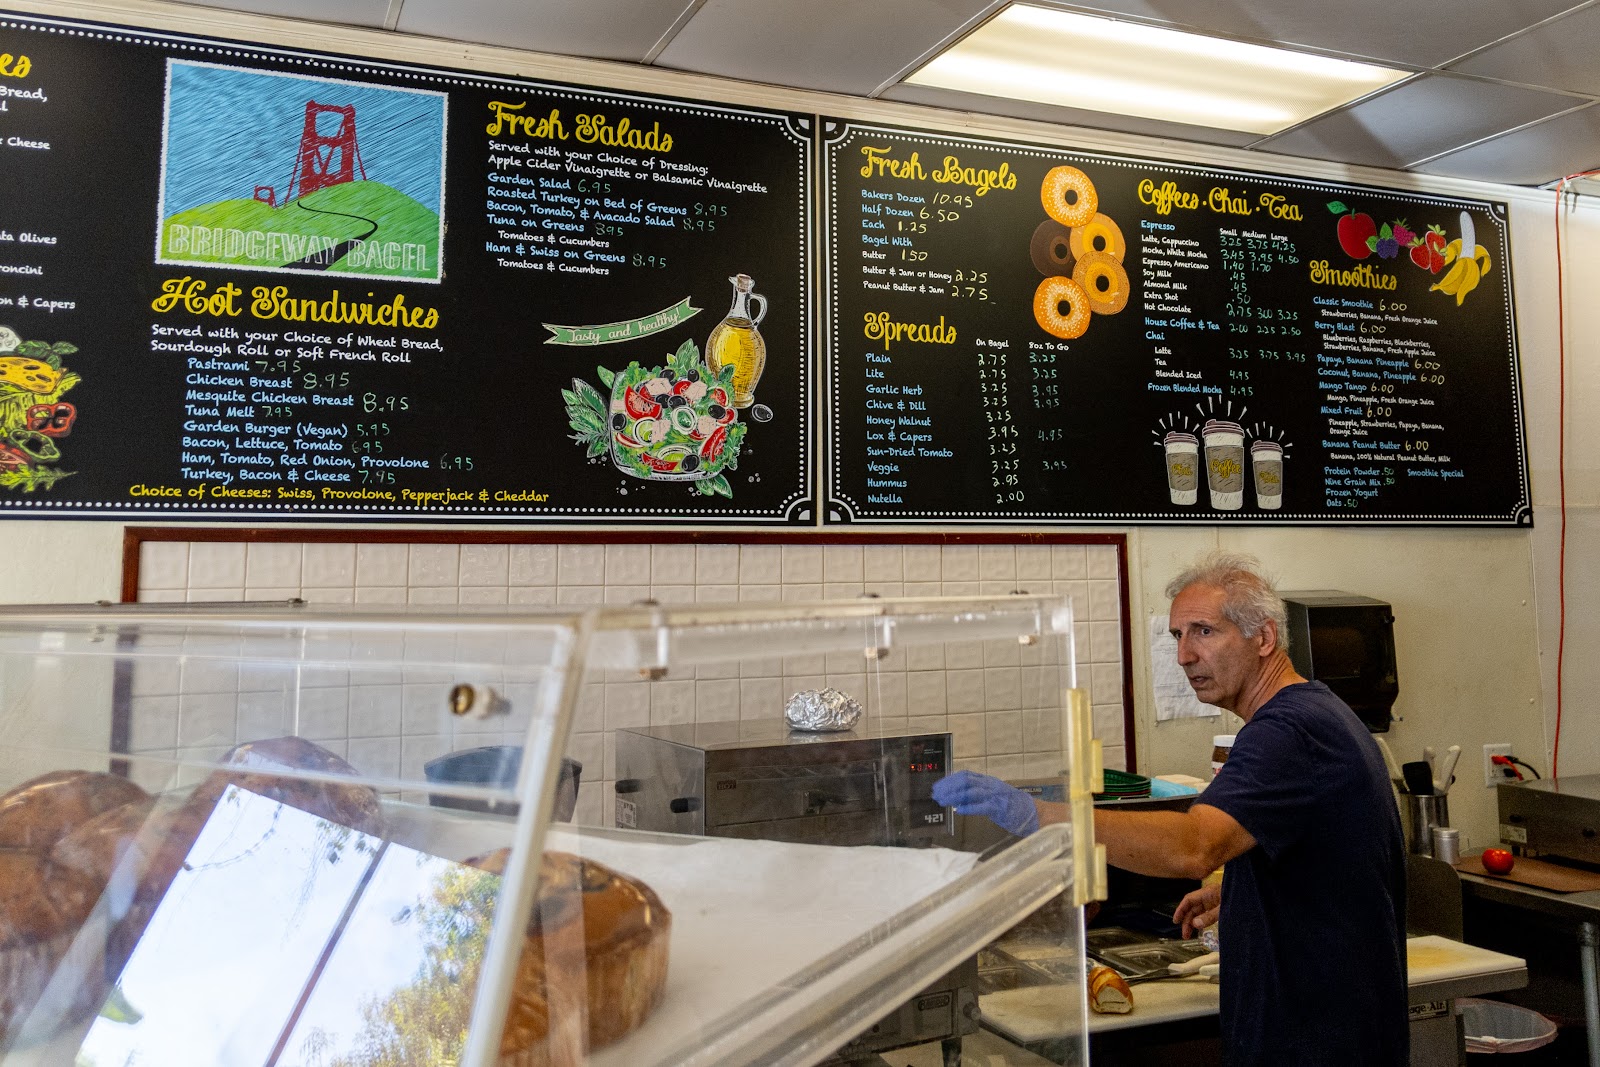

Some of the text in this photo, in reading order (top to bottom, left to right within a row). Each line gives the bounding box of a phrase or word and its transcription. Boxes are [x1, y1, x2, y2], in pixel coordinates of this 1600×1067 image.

[486, 101, 673, 152] Fresh Salads
[8, 137, 50, 149] Cheese
[488, 140, 708, 176] Served with your Choice of Dressing:
[488, 155, 522, 170] Apple
[526, 159, 561, 171] Cider
[565, 162, 630, 178] Vinaigrette
[653, 173, 703, 186] Balsamic
[707, 178, 767, 193] Vinaigrette
[860, 146, 1017, 196] Fresh Bagels
[488, 172, 534, 186] Garden
[539, 178, 571, 189] Salad
[862, 190, 893, 200] Bakers
[896, 193, 925, 203] Dozen
[1138, 179, 1303, 221] Coffees Chai Tea
[862, 205, 959, 222] Half Dozen 6.50
[862, 220, 927, 233] Each 1.25
[1141, 220, 1175, 233] Espresso
[20, 233, 57, 244] Olives
[862, 235, 912, 247] Bagel With
[1220, 228, 1288, 243] Small Medium Large
[486, 242, 510, 253] Ham
[516, 243, 525, 256] &
[530, 246, 559, 257] Swiss
[564, 250, 579, 259] on
[583, 251, 625, 263] Greens
[497, 258, 609, 275] Tomatoes & Cucumbers
[863, 266, 886, 275] Butter
[889, 267, 896, 276] &
[899, 268, 914, 276] Jam
[929, 271, 952, 282] Honey
[955, 270, 987, 283] 2.25
[1310, 260, 1397, 290] Smoothies
[863, 281, 987, 300] Peanut Butter & Jam 2.75
[34, 298, 76, 313] Capers
[152, 276, 439, 329] Hot Sandwiches
[1144, 303, 1191, 313] Hot Chocolate
[1313, 297, 1407, 311] Classic Smoothie 6.00
[1145, 317, 1220, 330] House Coffee & Tea
[1321, 309, 1358, 320] Strawberries,
[1385, 314, 1400, 322] Fresh
[1402, 316, 1422, 325] Orange
[1423, 317, 1438, 325] Juice
[568, 308, 681, 345] Tasty and healthy!
[864, 312, 957, 350] Spreads
[151, 324, 444, 352] Served with your Choice of Wheat Bread,
[1146, 331, 1165, 340] Chai
[976, 338, 1009, 349] On Bagel
[1045, 342, 1054, 350] To
[1057, 343, 1069, 351] Go
[151, 340, 411, 363] Sourdough Roll or Soft French Roll
[188, 357, 301, 372] Pastrami 7.95
[866, 353, 892, 363] Plain
[978, 353, 1006, 366] 2.75
[186, 372, 349, 389] Chicken Breast 8.95
[1319, 382, 1394, 393] Mango Tango 6.00
[866, 384, 922, 395] Garlic Herb
[185, 405, 220, 417] Tuna
[226, 406, 254, 417] Melt
[866, 415, 931, 429] Honey Walnut
[183, 420, 390, 439] Garden Burger (Vegan) 5.95
[867, 447, 953, 458] Sun-Dried Tomato
[1322, 440, 1350, 448] Banana
[1353, 441, 1377, 449] Peanut
[1405, 441, 1428, 451] 6.00
[1407, 469, 1464, 481] Smoothie Special
[867, 478, 907, 488] Hummus
[129, 483, 549, 506] Choice of Cheeses: Swiss, Provolone, Pepperjack & Cheddar
[867, 491, 1025, 504] Nutella 2.00
[1326, 488, 1378, 499] Frozen Yogurt
[925, 813, 943, 823] 421
